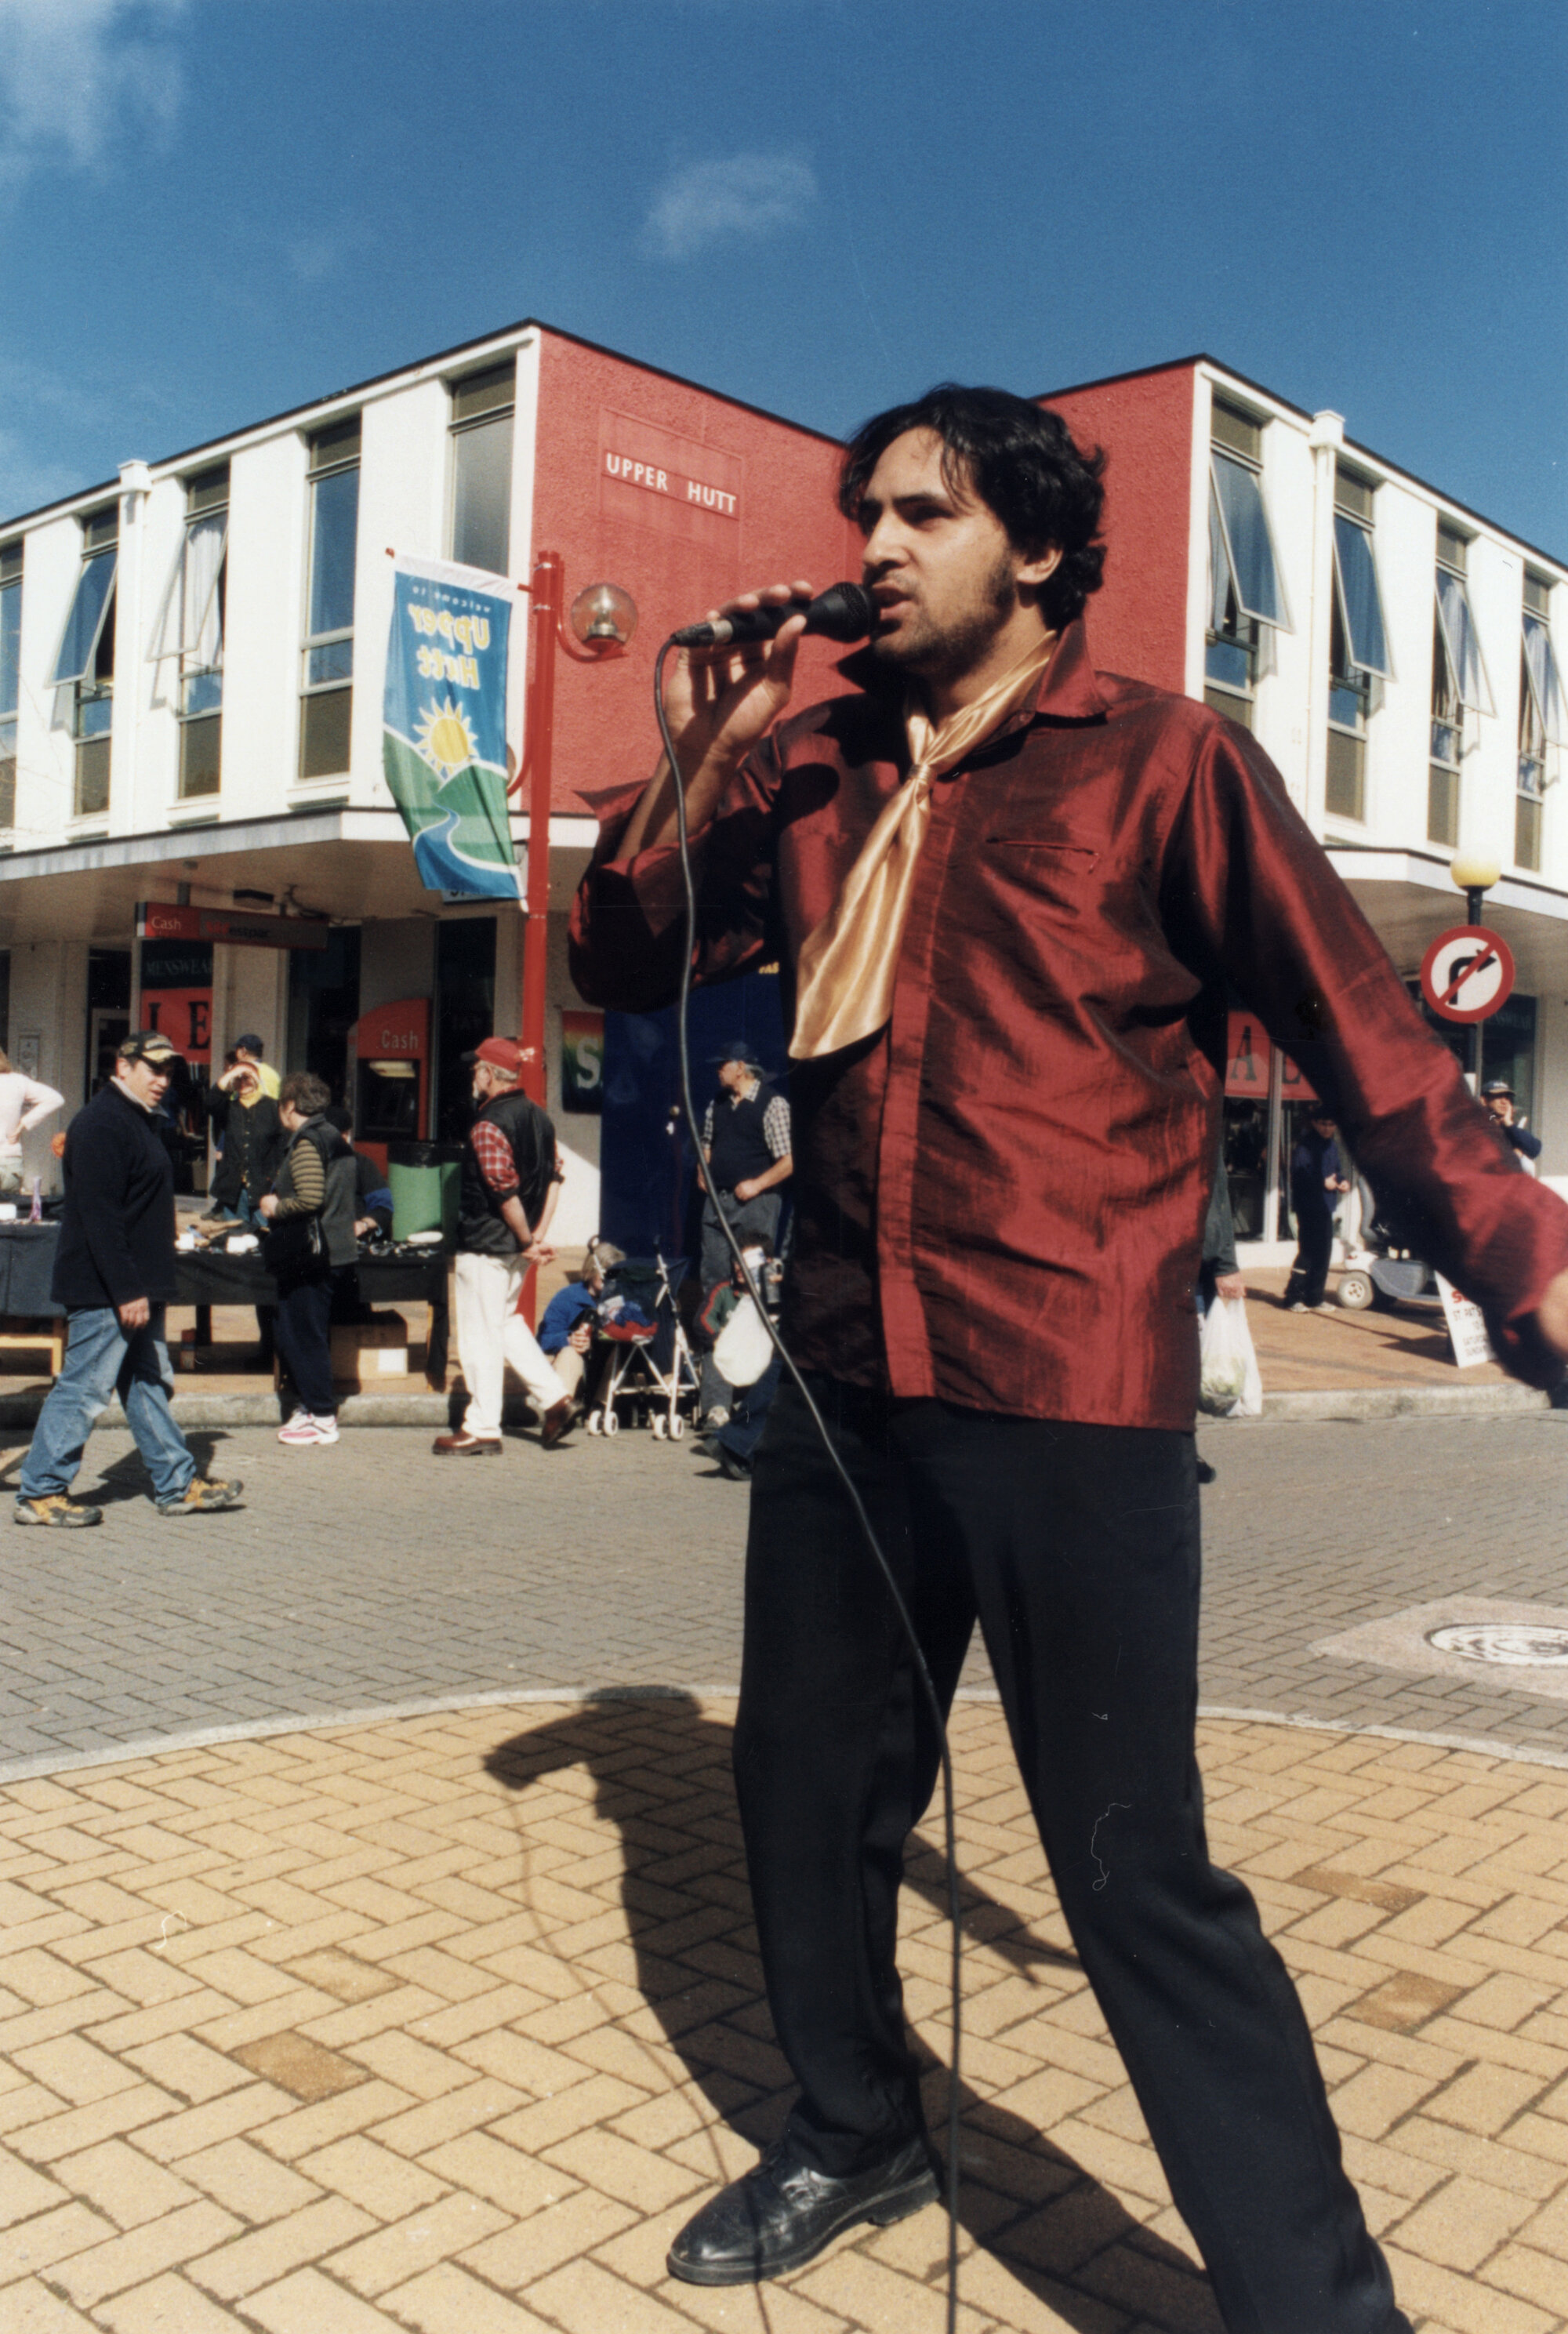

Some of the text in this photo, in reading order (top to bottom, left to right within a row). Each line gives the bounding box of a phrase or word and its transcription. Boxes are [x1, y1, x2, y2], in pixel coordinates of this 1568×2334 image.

[607, 452, 736, 514] UPPER HUTT
[151, 916, 182, 931] Cash
[146, 958, 211, 977] MENSWEA
[381, 1029, 419, 1051] Cash
